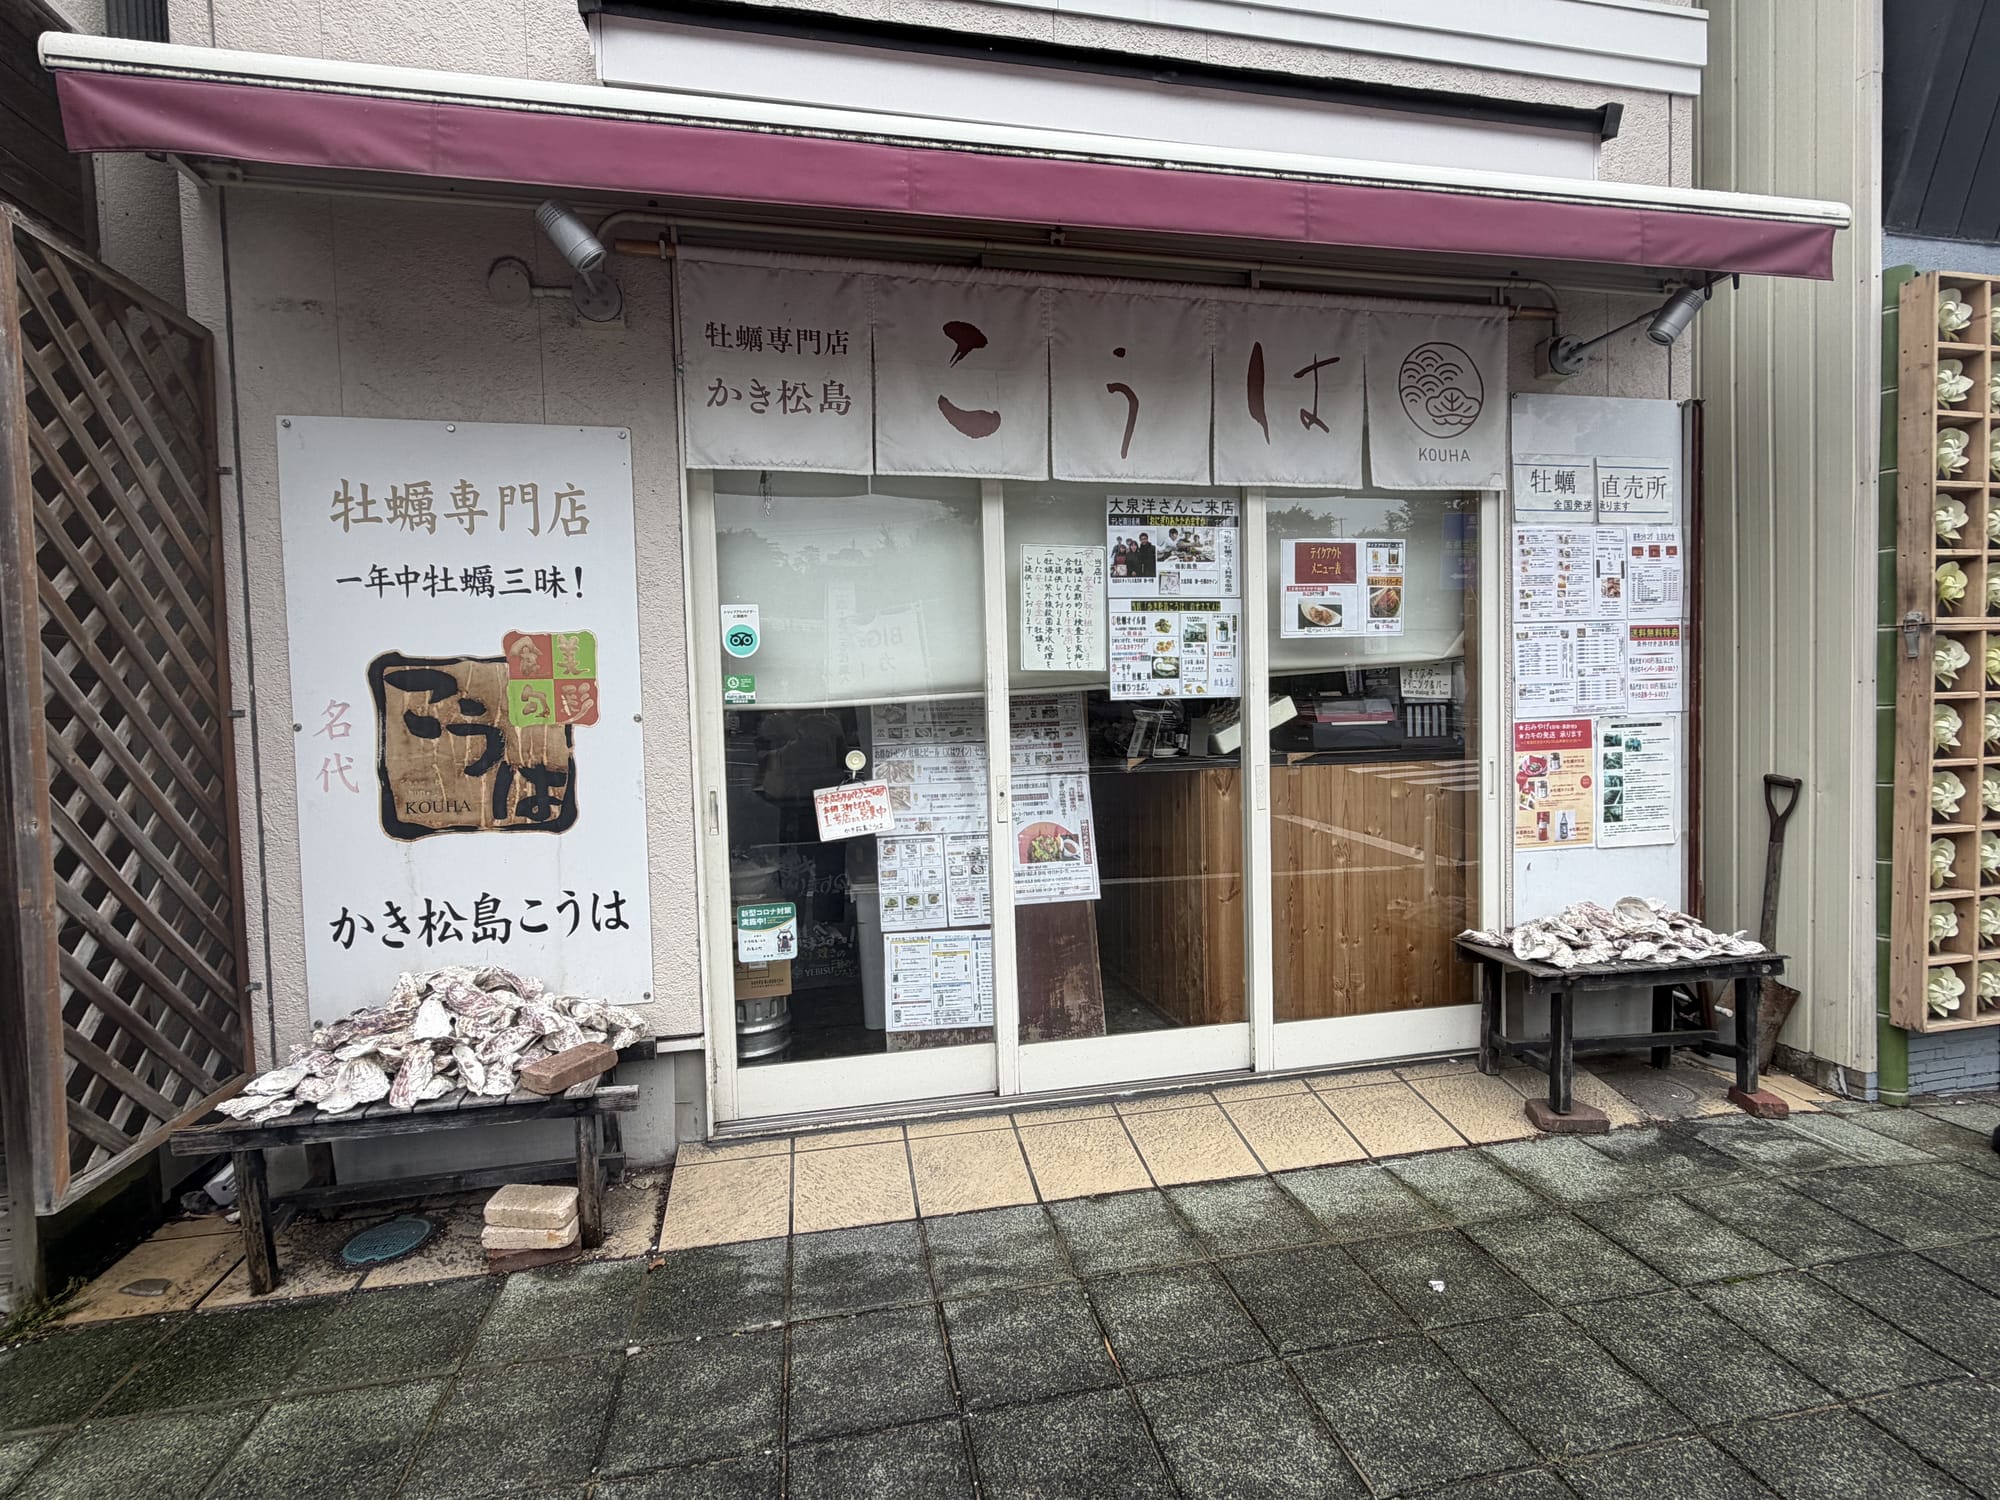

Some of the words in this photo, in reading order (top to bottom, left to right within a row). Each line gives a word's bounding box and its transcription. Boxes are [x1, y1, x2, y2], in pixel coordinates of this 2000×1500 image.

[705, 321, 849, 356] 牡蠣専門店
[706, 378, 852, 416] かき松島
[1418, 446, 1472, 464] KOUHA
[1530, 469, 1576, 495] 牡蠣
[1601, 474, 1667, 500] 直売所
[330, 477, 590, 538] 牡蠣専門店
[1109, 497, 1234, 515] 大泉洋さんご来店
[1553, 499, 1593, 511] 全国発送
[1310, 547, 1341, 560] テイクアウト
[1311, 561, 1341, 575] メニュー表
[314, 699, 359, 795] 名代
[405, 799, 472, 816] KOUHA
[330, 890, 630, 949] かき松島こうは
[741, 907, 792, 917] 新型コロナ対策
